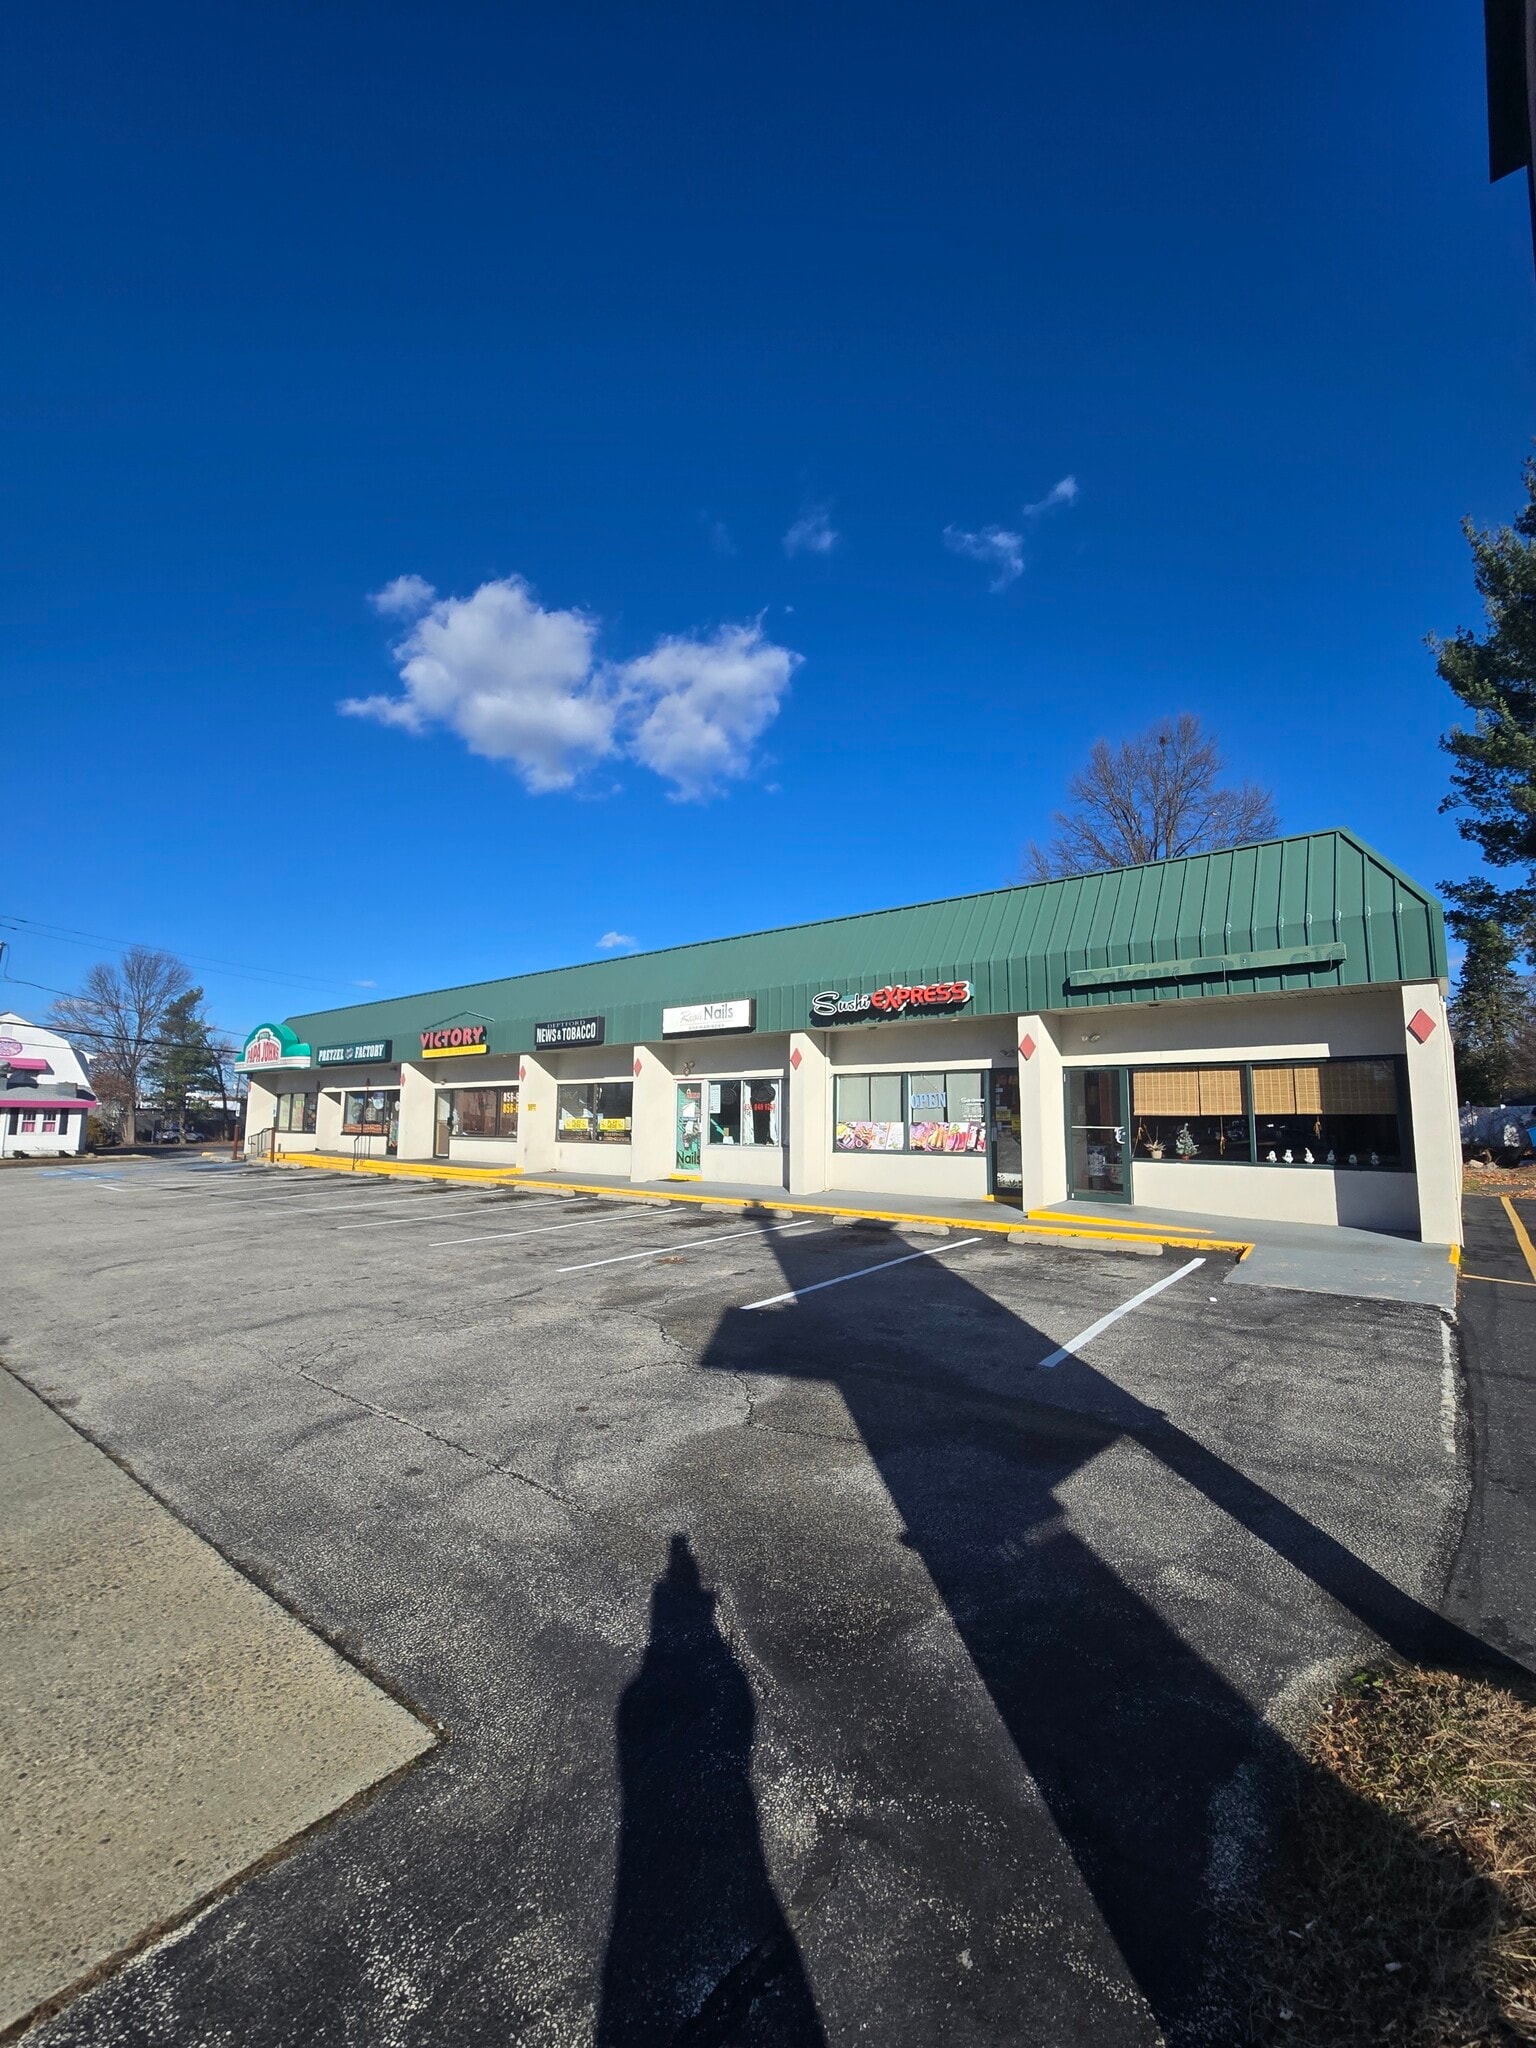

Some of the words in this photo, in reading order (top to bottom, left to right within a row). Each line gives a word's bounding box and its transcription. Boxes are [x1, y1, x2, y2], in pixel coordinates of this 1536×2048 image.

[704, 1004, 734, 1021] Nails
[812, 991, 871, 1016] Sushi
[420, 1024, 484, 1049] VICTORY
[536, 1027, 557, 1043] NEWS
[557, 1029, 562, 1041] &
[562, 1022, 597, 1041] TOBACCO
[247, 1042, 261, 1063] PAPA
[318, 1048, 344, 1061] PRETZEL
[354, 1044, 384, 1059] FACTORY
[911, 1092, 947, 1109] OPEN
[676, 1151, 701, 1165] Nails
